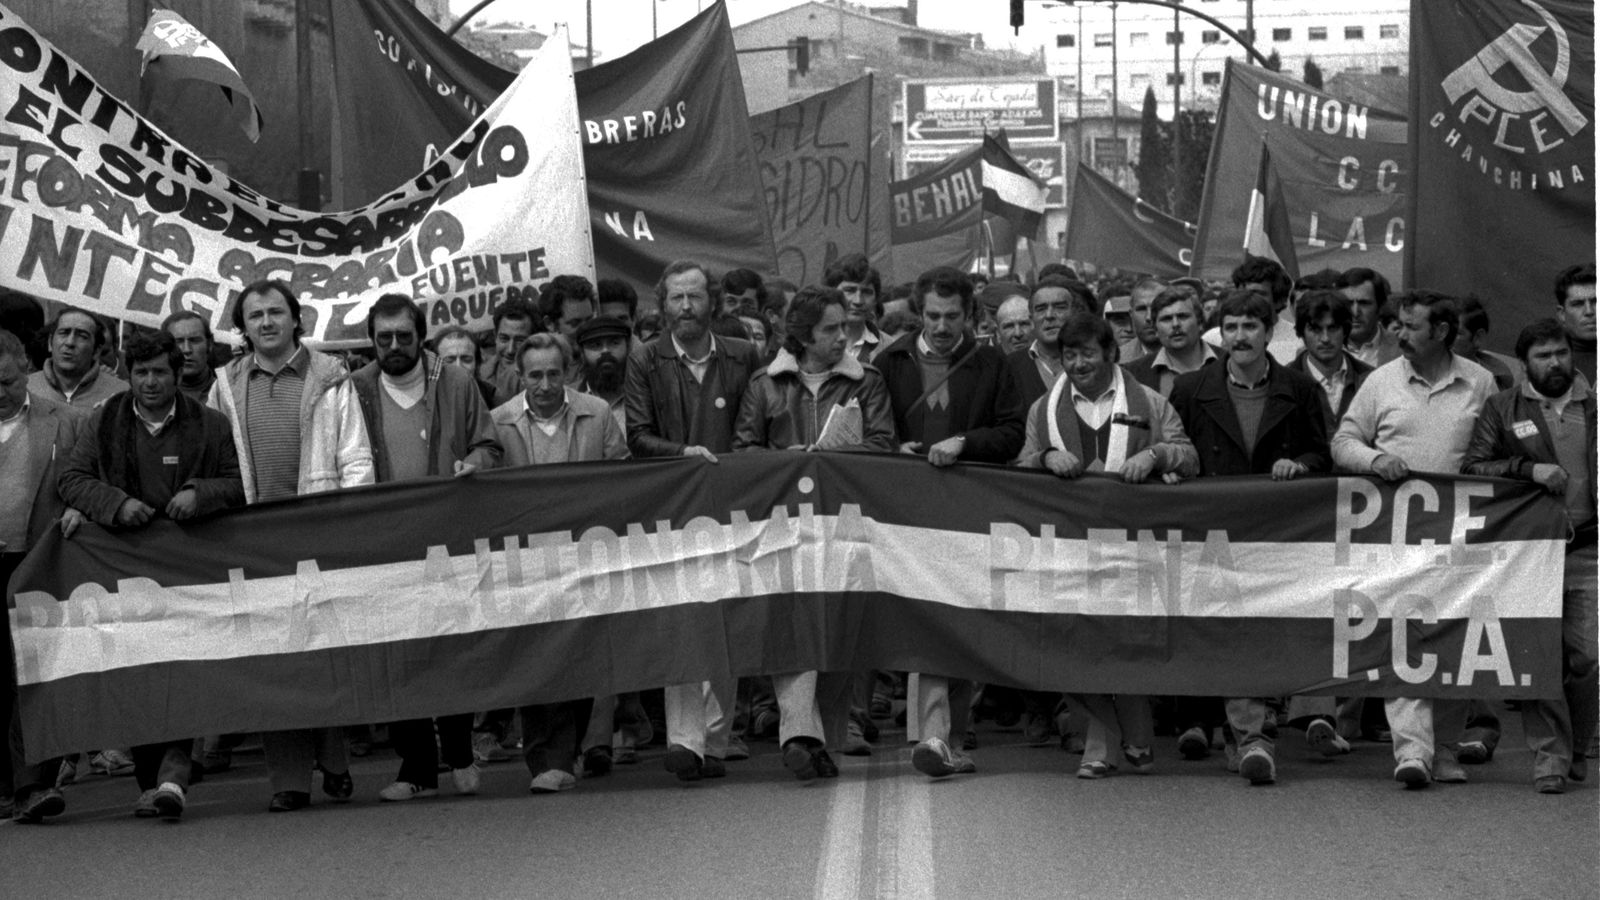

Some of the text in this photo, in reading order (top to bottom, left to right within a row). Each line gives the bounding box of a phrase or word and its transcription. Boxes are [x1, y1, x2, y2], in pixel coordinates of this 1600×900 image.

[0, 11, 213, 184] ONTRA
[1257, 83, 1369, 140] UNION
[1458, 95, 1564, 154] PCE
[5, 84, 529, 258] EL SUBDESARRLLO
[411, 247, 550, 299] FUENTE
[989, 522, 1243, 617] PLENA
[1332, 588, 1532, 687] P.C.A.
